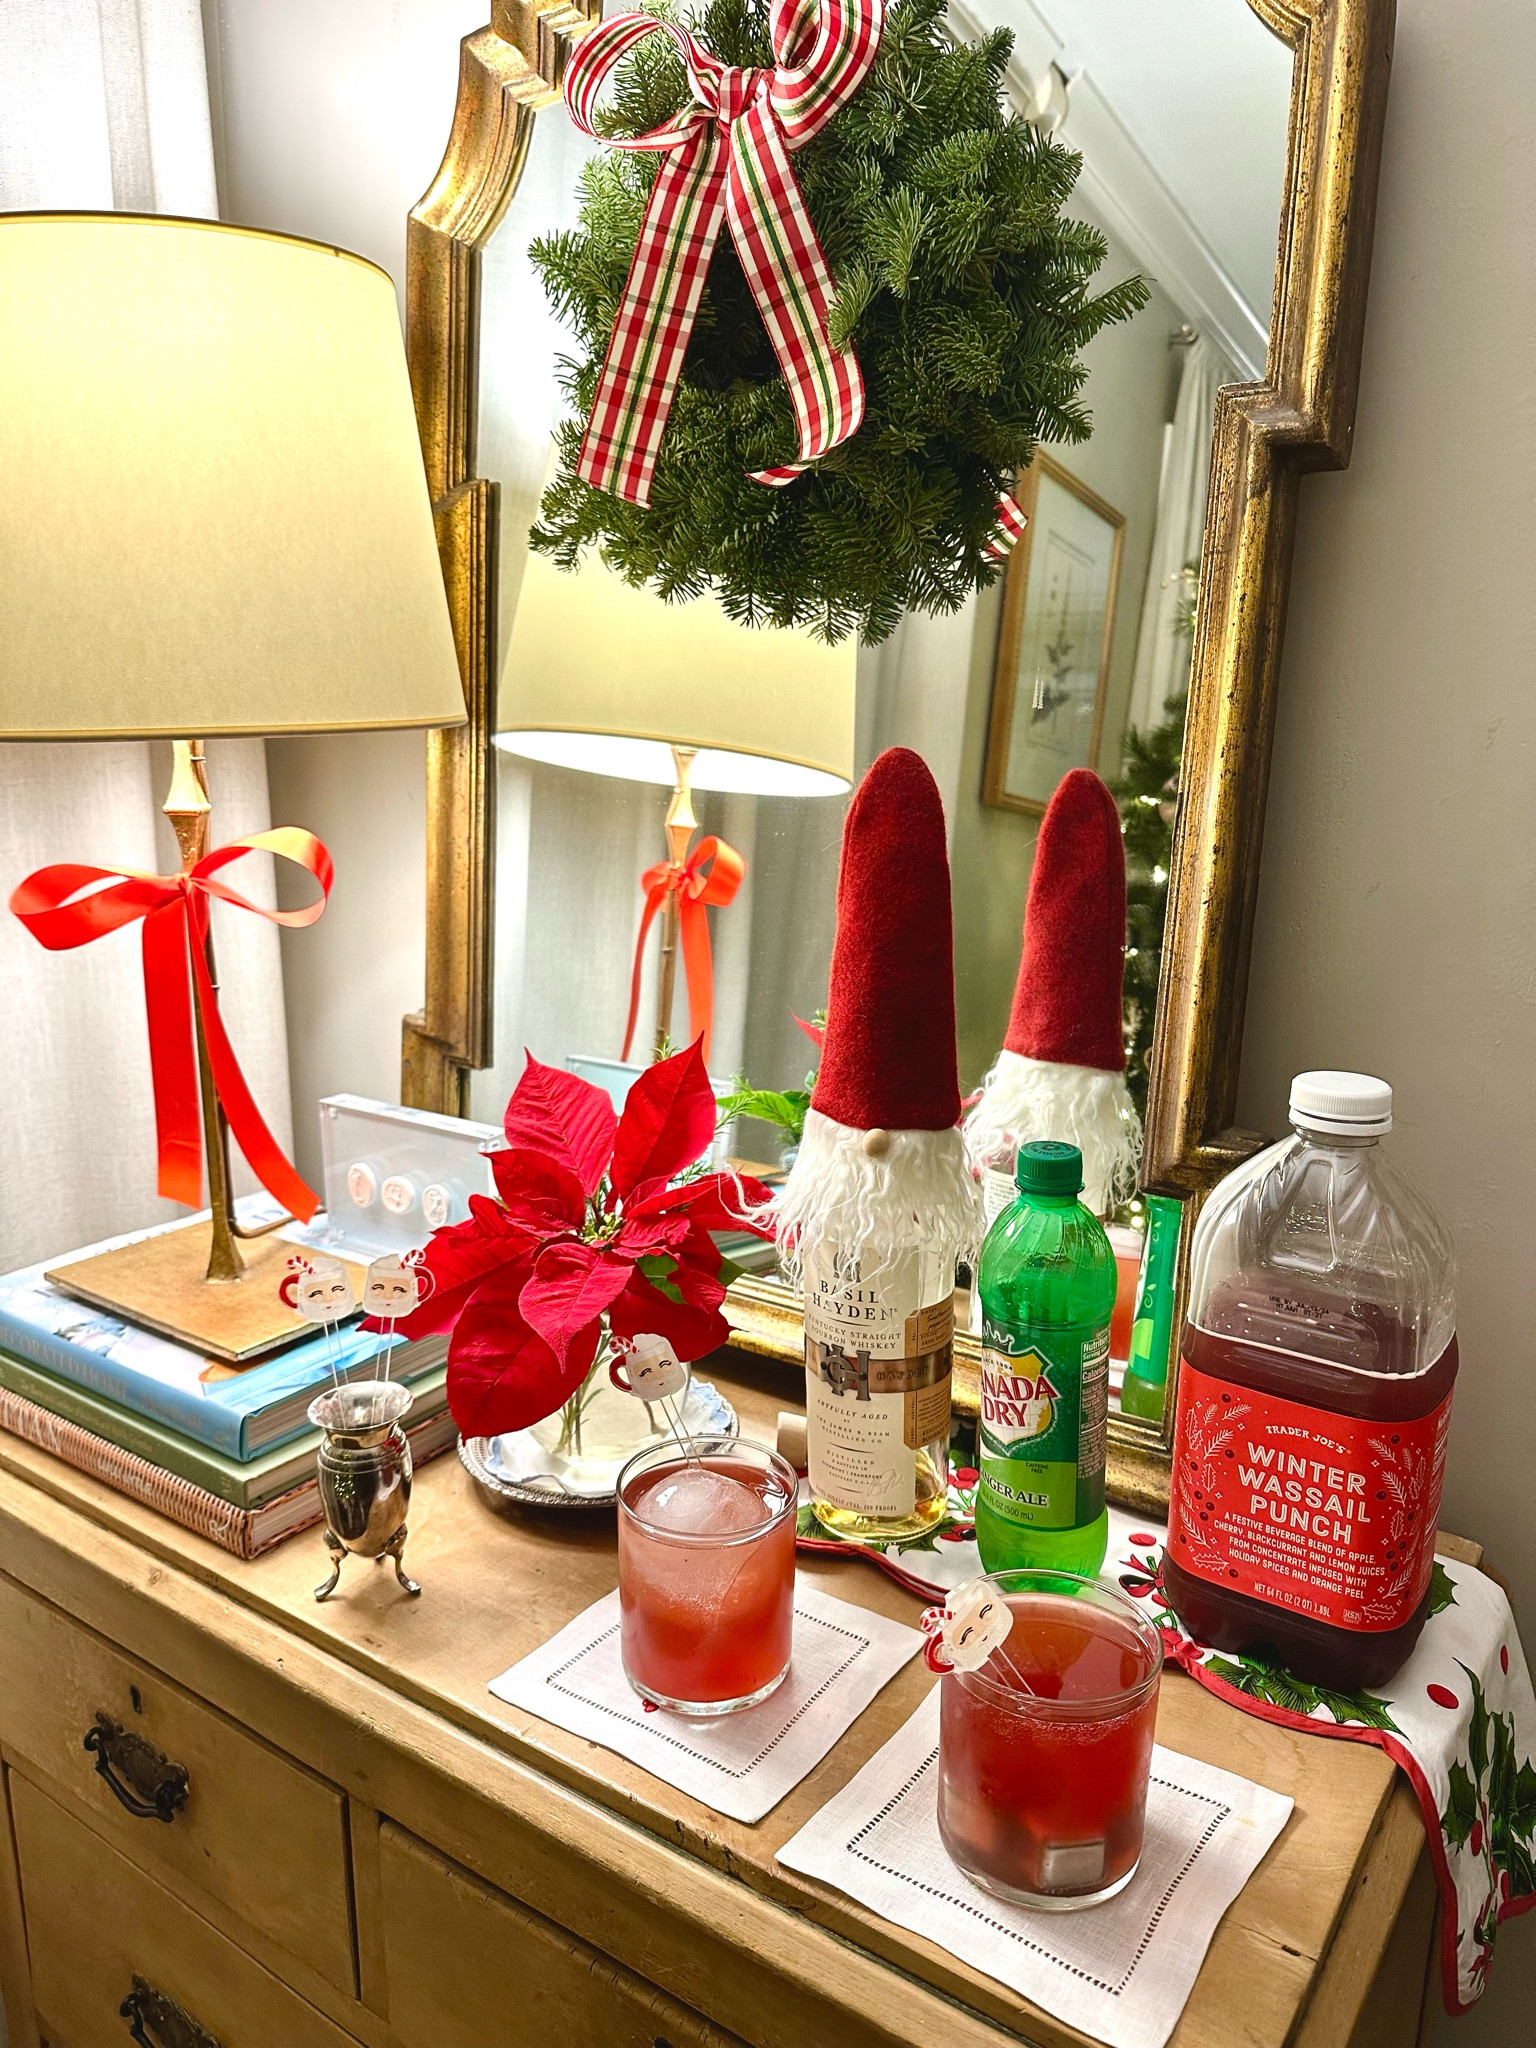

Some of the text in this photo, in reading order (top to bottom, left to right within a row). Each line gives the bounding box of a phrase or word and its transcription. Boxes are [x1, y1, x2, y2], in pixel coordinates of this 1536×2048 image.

[808, 1313, 846, 1335] KENTUCKY
[850, 1331, 902, 1340] STRAIGHT
[811, 1324, 896, 1349] BOURBON WHISKEY
[982, 1369, 1059, 1401] NADA
[817, 1398, 857, 1417] ARTFULLY
[983, 1395, 1027, 1427] DRY
[1265, 1425, 1346, 1454] TRADER JOE'S
[1025, 1462, 1049, 1470] CAFFEINE
[1247, 1441, 1366, 1496] WINTER
[981, 1466, 1048, 1506] NGER ALE
[1237, 1464, 1371, 1523] WASSAIL
[995, 1499, 1004, 1510] OZ
[1004, 1505, 1019, 1517] (500
[1250, 1494, 1352, 1545] PUNCH
[1213, 1519, 1386, 1576] CHERRY, BLACKCURRANT AND LEMON JUICES
[1224, 1511, 1376, 1565] A FESTIVE BEVERAGE BLEND OF APPLE,
[1228, 1548, 1365, 1599] HOLIDAY SPICES AND ORANGE PEEL
[1229, 1536, 1367, 1587] FROM CONCENTRATE INFUSED WITH
[1253, 1581, 1331, 1617] NET 64 FL OZ (2 QT) 1.89L
